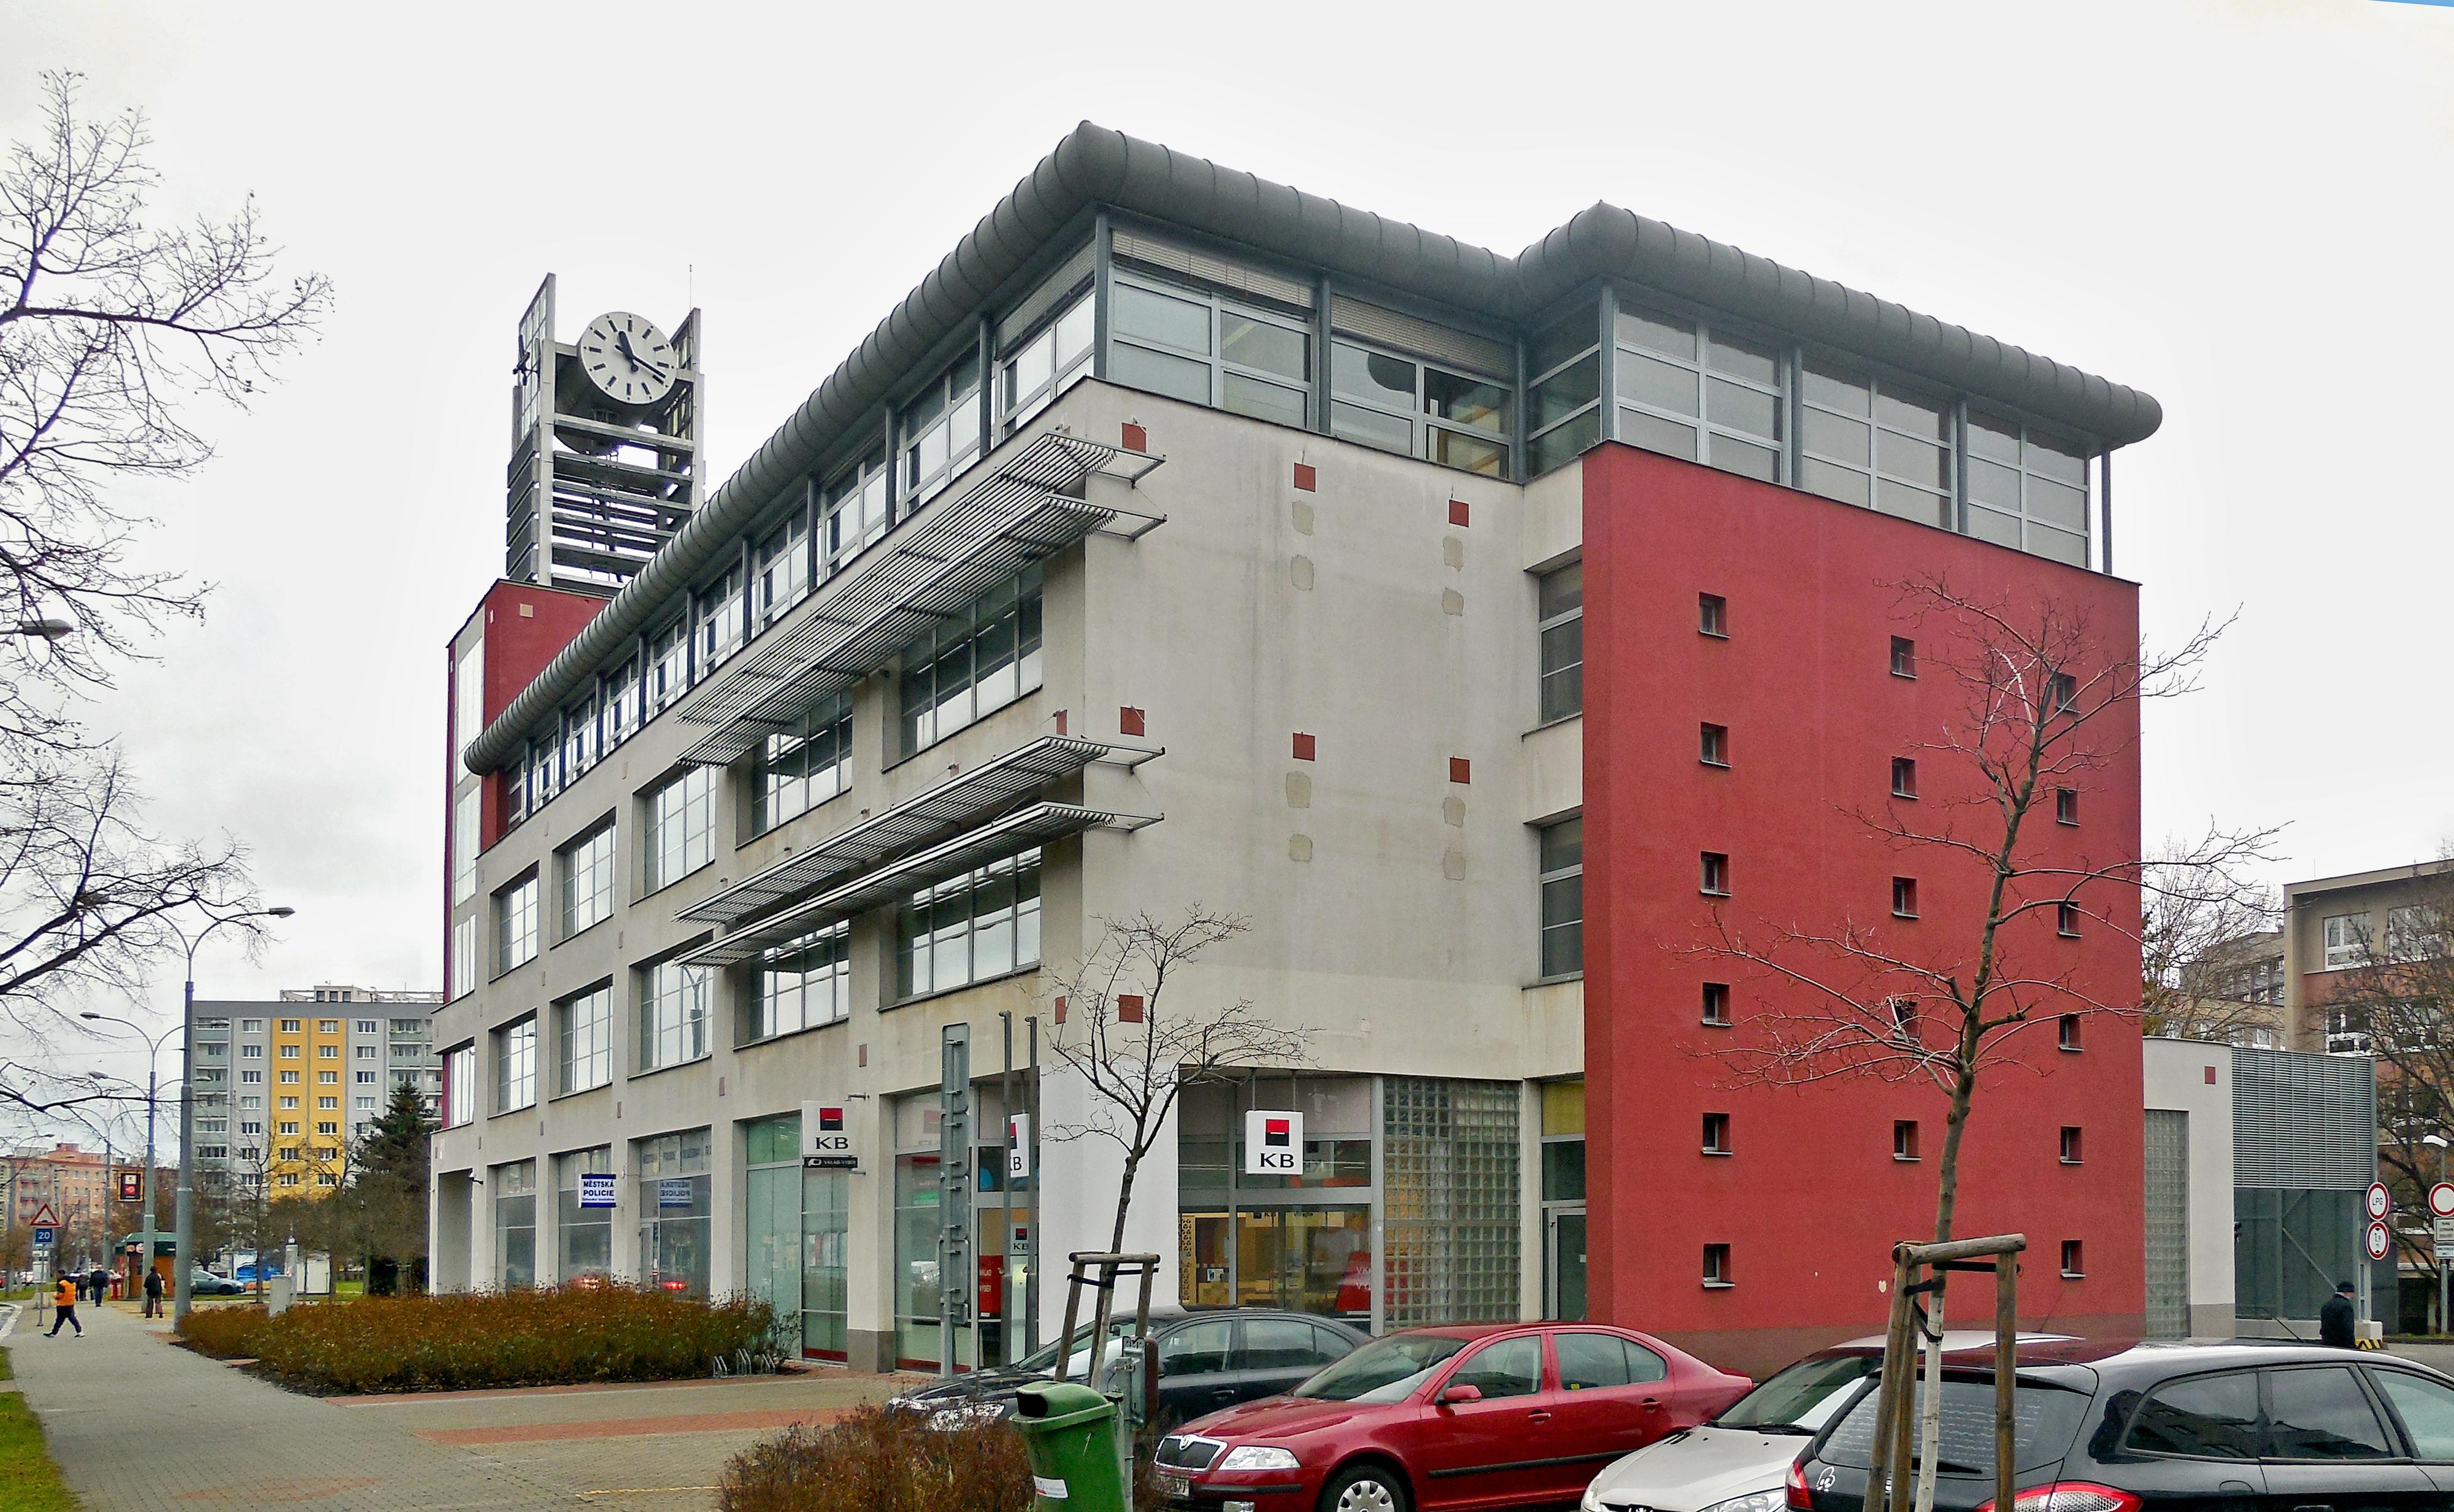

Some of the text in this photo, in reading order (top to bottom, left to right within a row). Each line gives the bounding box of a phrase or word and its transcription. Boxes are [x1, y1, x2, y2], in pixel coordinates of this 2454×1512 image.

[815, 1137, 848, 1149] KB
[1010, 1156, 1022, 1171] B
[1260, 1153, 1294, 1168] KB
